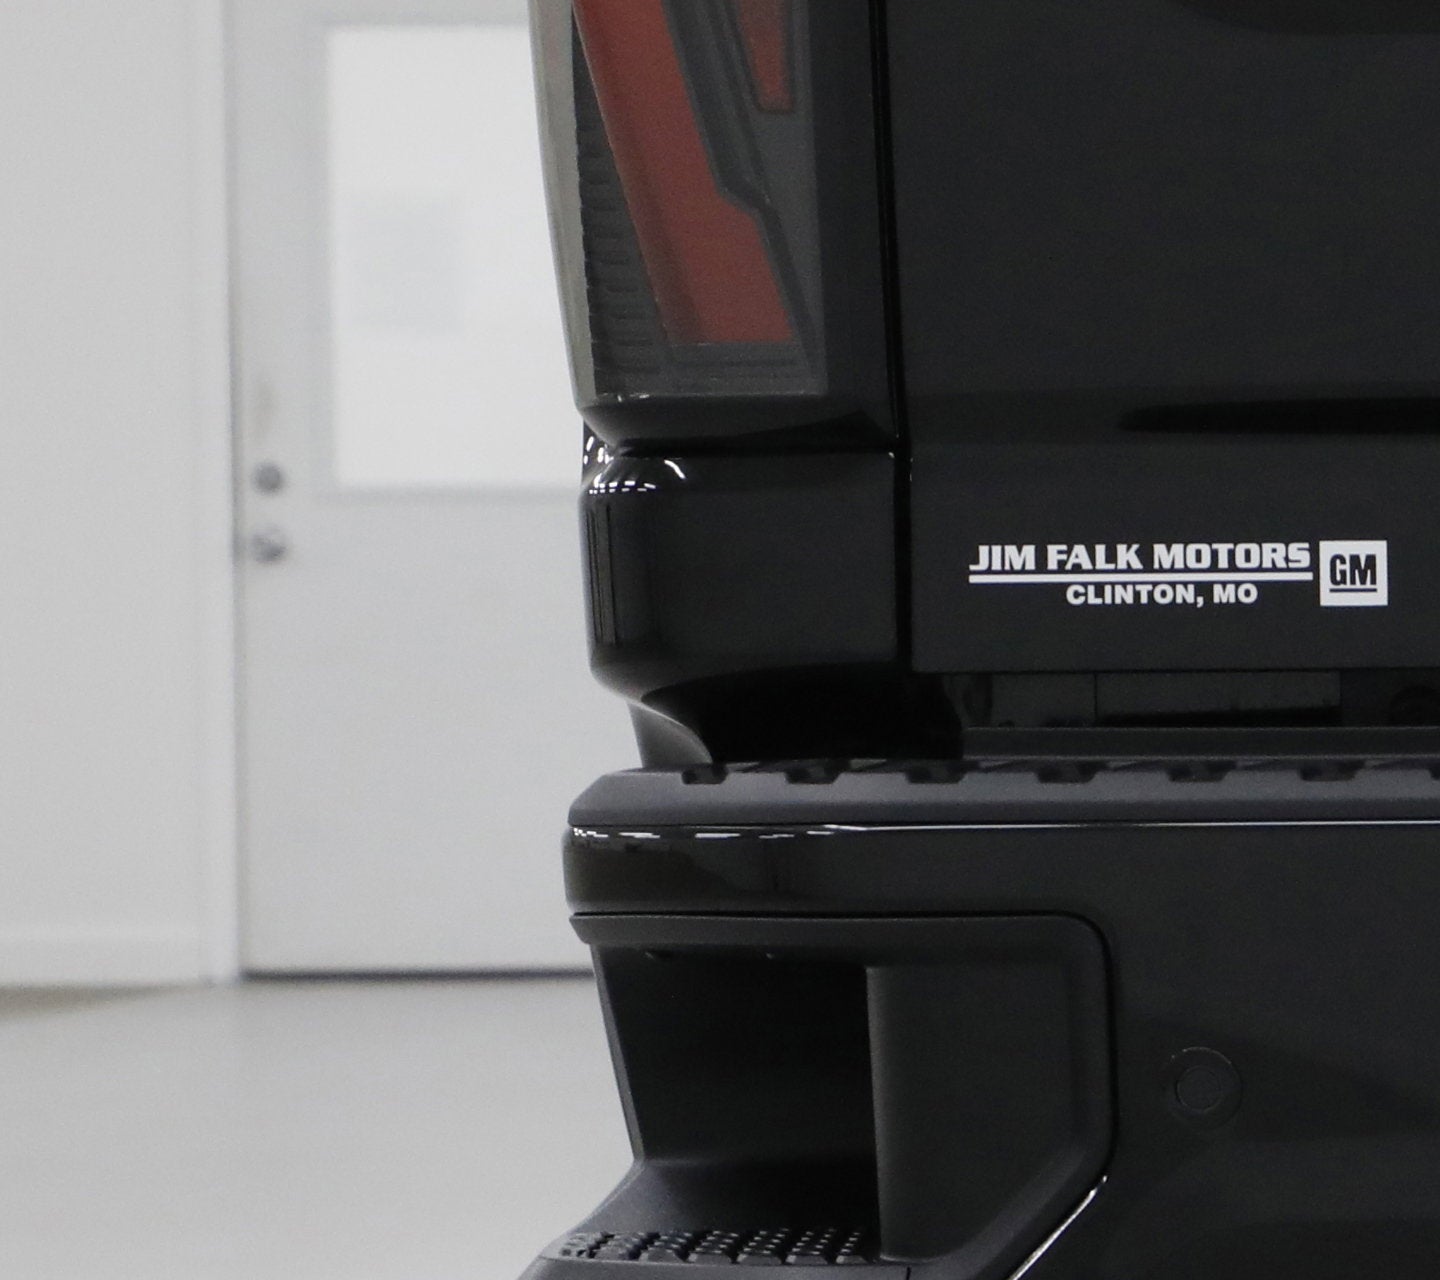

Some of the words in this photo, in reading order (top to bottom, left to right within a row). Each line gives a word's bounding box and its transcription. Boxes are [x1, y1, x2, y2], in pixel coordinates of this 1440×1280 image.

[969, 545, 1035, 571] JIM
[1047, 544, 1143, 570] FALK
[1154, 543, 1310, 569] MOTORS
[1330, 554, 1376, 586] GM
[1066, 584, 1203, 607] CLINTON,
[1213, 583, 1258, 603] MO
